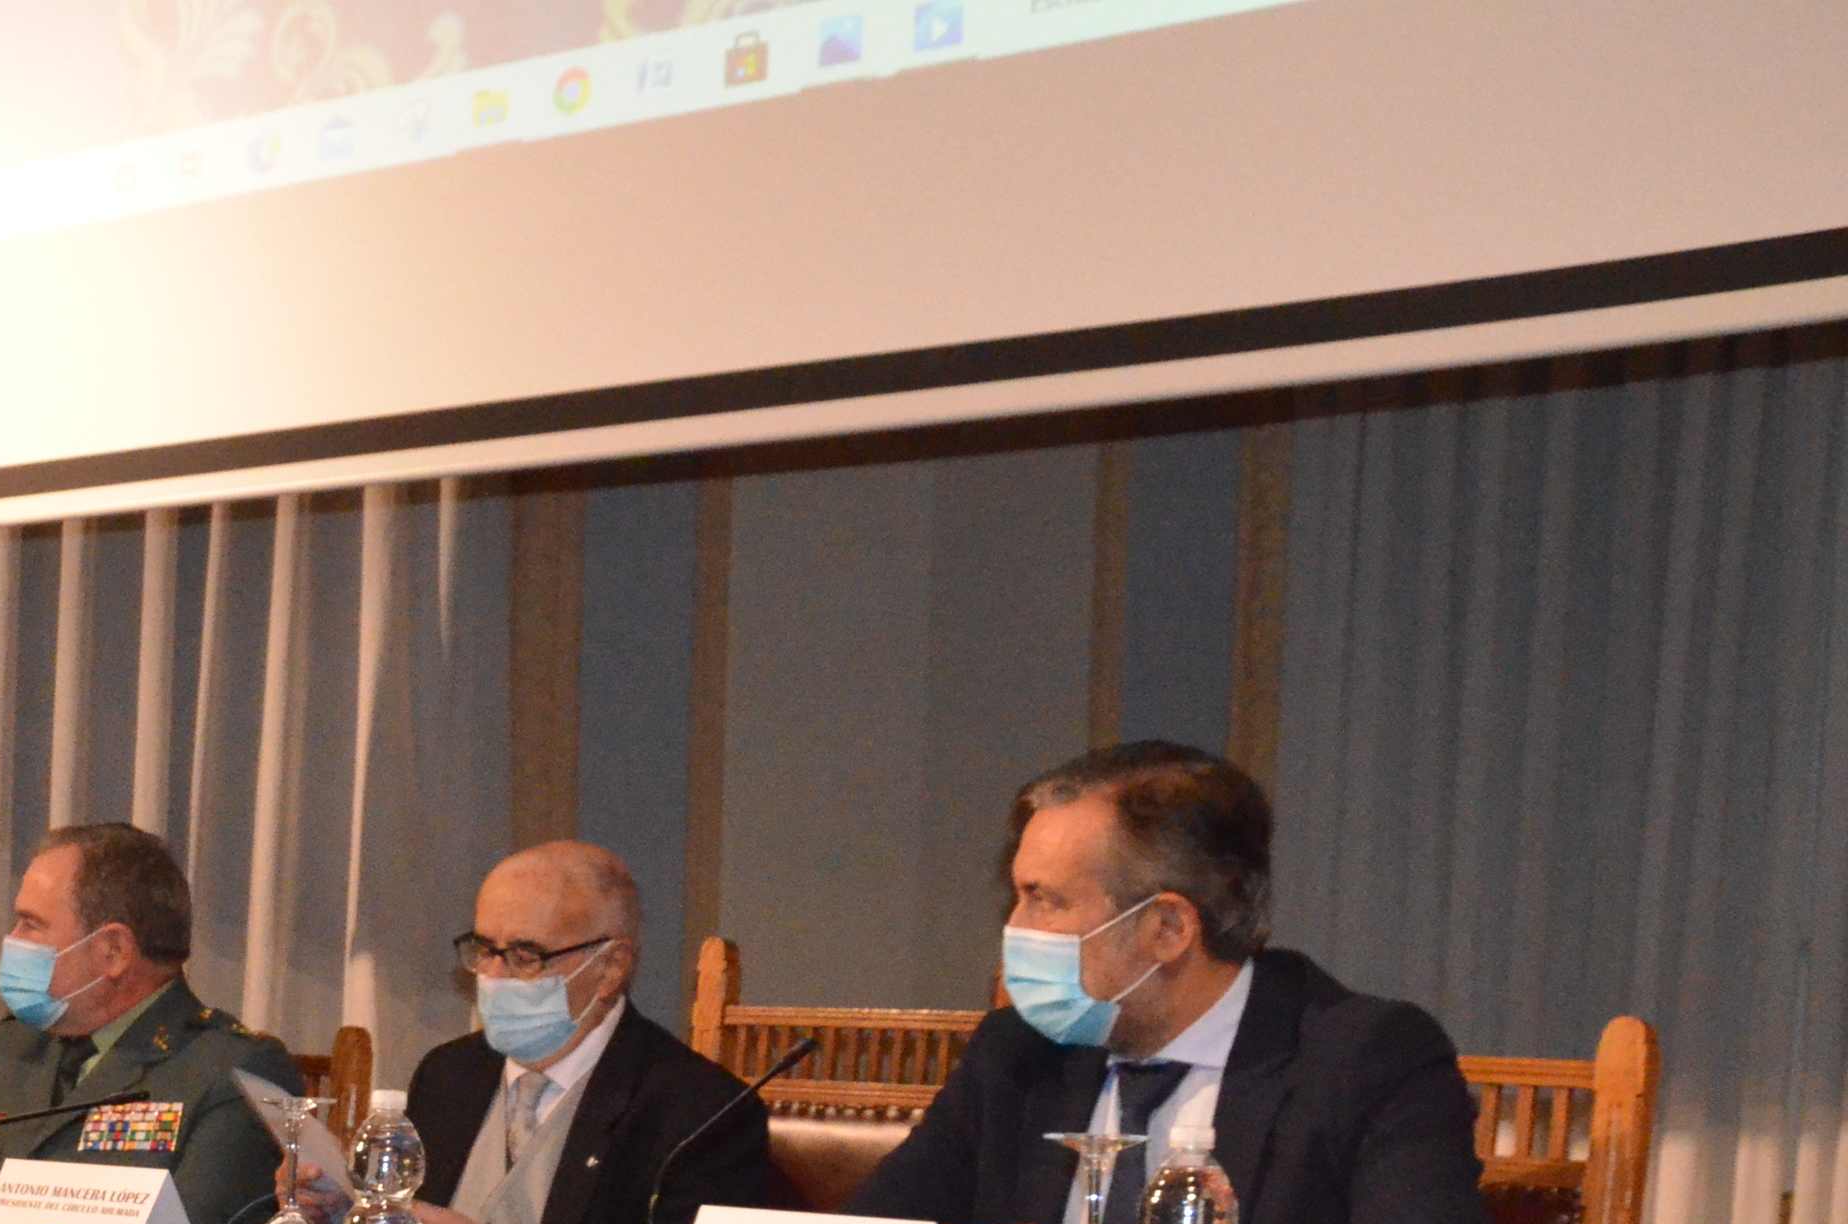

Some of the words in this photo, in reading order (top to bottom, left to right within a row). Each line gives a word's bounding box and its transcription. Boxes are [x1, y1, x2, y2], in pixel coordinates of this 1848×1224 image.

[51, 1185, 108, 1201] MANCERA
[109, 1187, 151, 1205] LÓPEZ
[44, 1201, 60, 1211] DEL
[100, 1206, 140, 1218] AHUMADA
